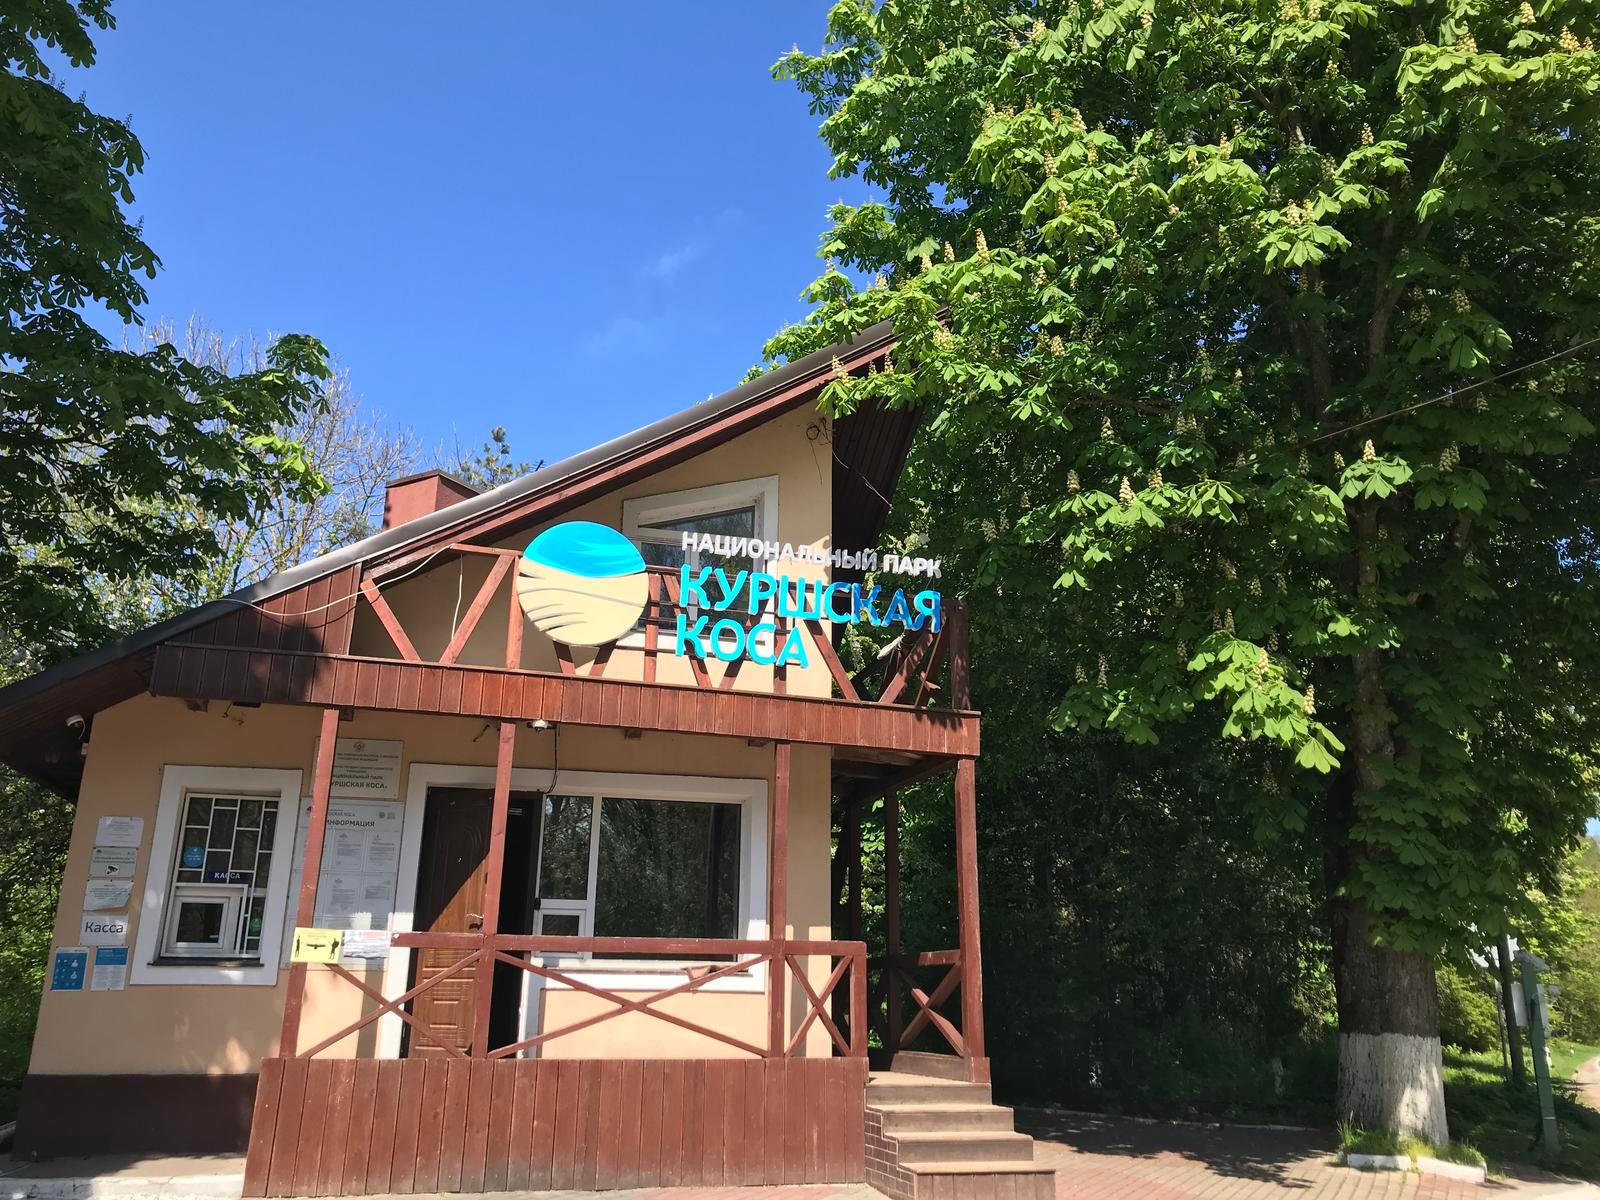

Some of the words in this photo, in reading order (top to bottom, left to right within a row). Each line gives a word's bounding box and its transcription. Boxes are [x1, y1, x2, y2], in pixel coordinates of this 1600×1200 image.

[681, 530, 878, 571] НАЦИОНАЛЬНЫЙ
[882, 554, 942, 578] ПАРК
[679, 564, 942, 633] КУРШСКАЯ
[675, 614, 809, 669] КОСА
[331, 780, 365, 788] УРШСКАЯ
[84, 921, 125, 934] Касса
